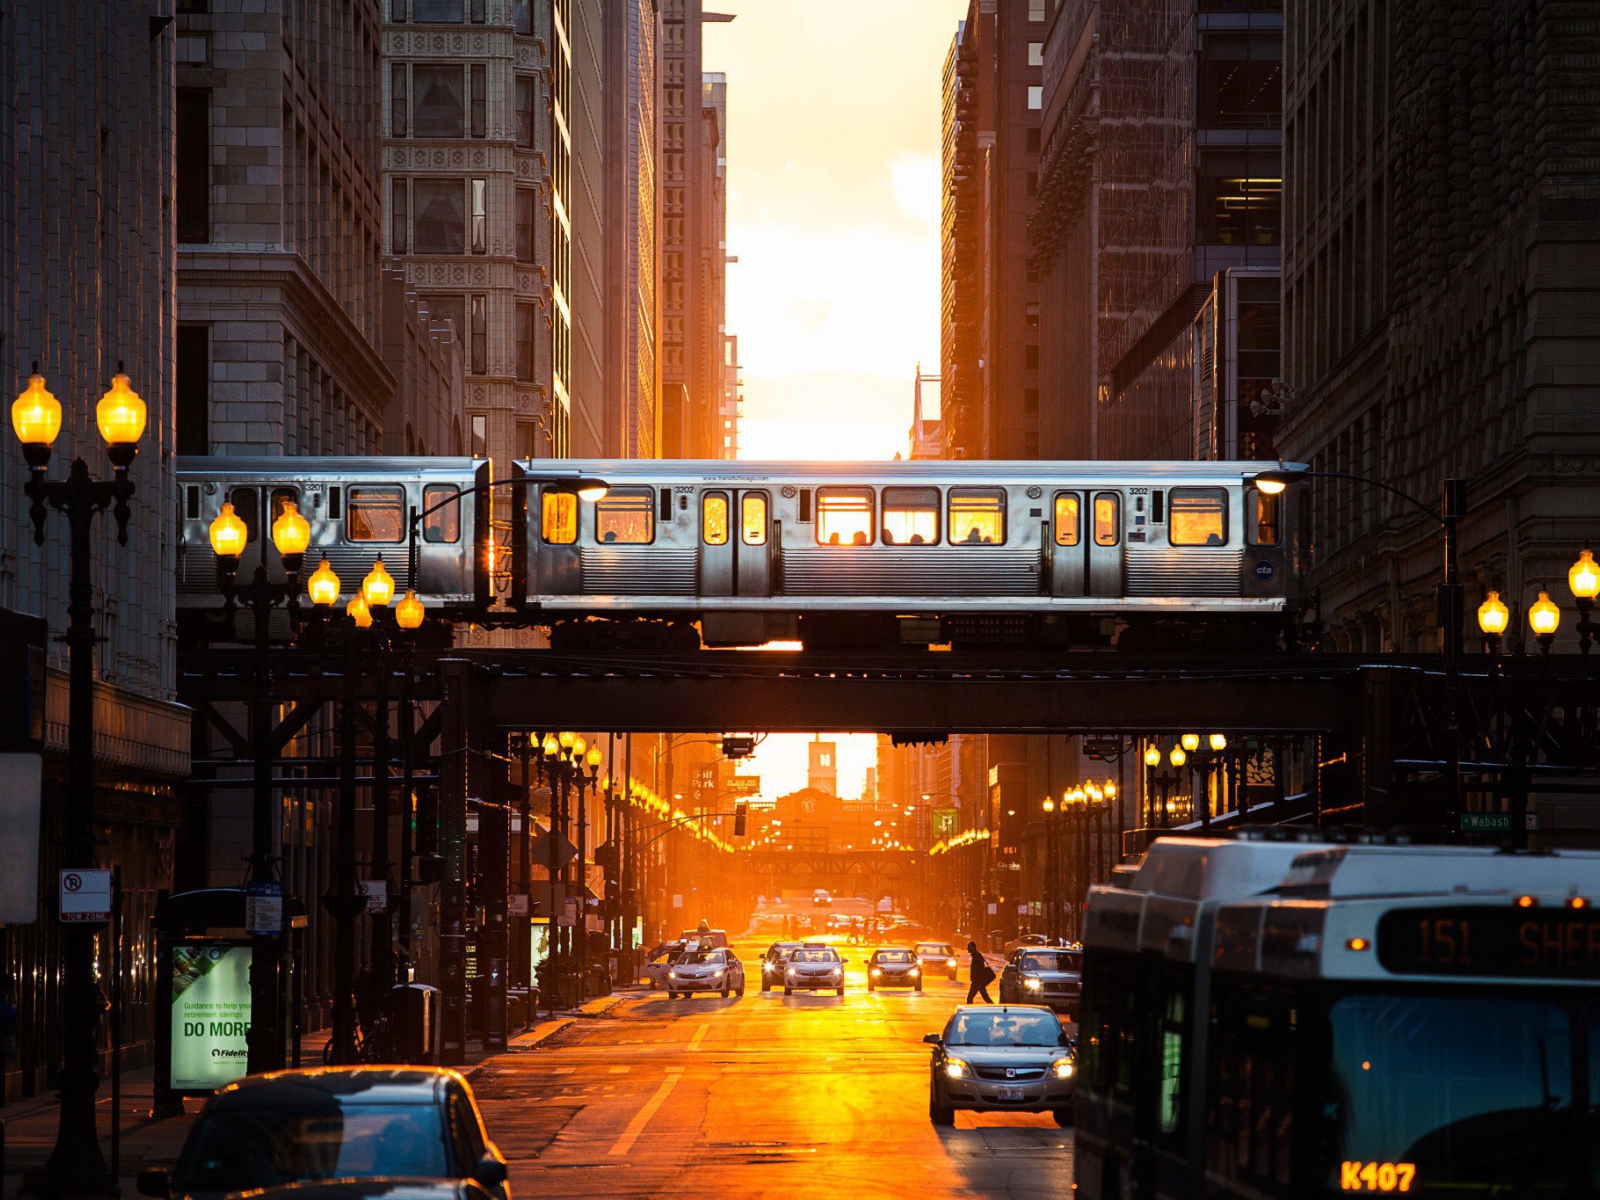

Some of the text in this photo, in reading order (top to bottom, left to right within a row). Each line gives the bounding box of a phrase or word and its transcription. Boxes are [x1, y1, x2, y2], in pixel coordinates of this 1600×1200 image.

[305, 483, 324, 491] 3201
[675, 486, 694, 494] 3202
[1129, 487, 1148, 495] 3202
[1256, 566, 1272, 574] cta
[1471, 815, 1509, 827] Wabash
[67, 912, 105, 920] TOW ZONE
[1420, 918, 1472, 965] 151
[184, 1002, 213, 1010] Guidance
[224, 1002, 238, 1012] help
[184, 1011, 243, 1020] retirement savings
[184, 1021, 205, 1037] DO
[1341, 1160, 1416, 1192] K407
